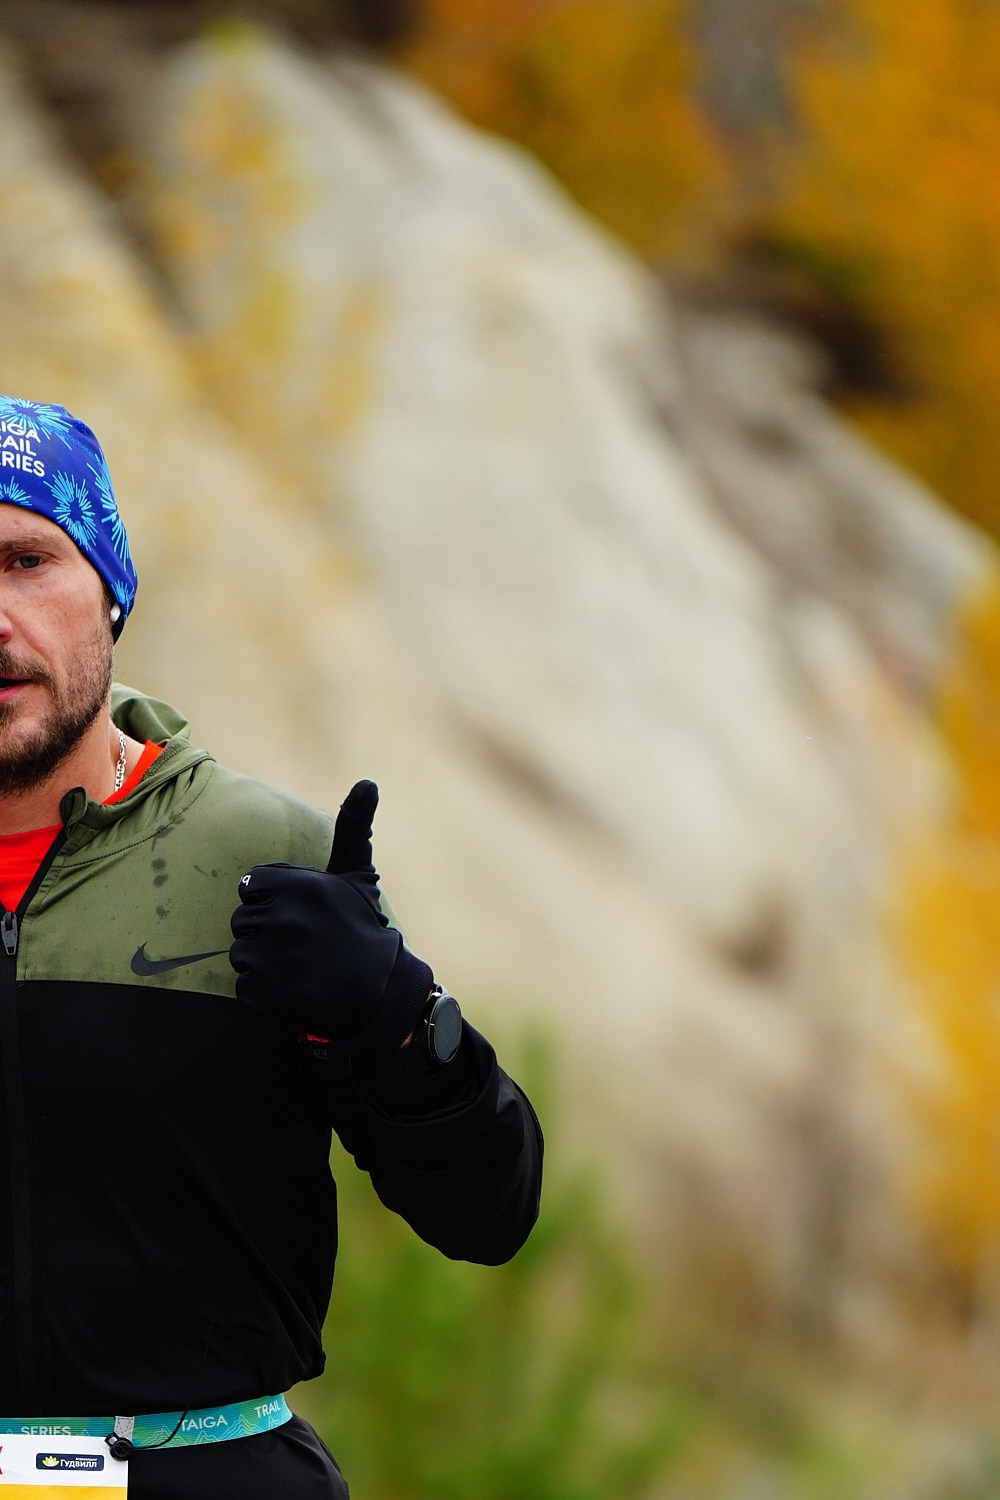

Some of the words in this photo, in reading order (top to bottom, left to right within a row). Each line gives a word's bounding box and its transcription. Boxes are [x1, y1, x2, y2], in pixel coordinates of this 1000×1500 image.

[178, 1414, 228, 1431] TAIGA
[254, 1400, 281, 1418] TRAIL
[20, 1426, 71, 1436] SERIES
